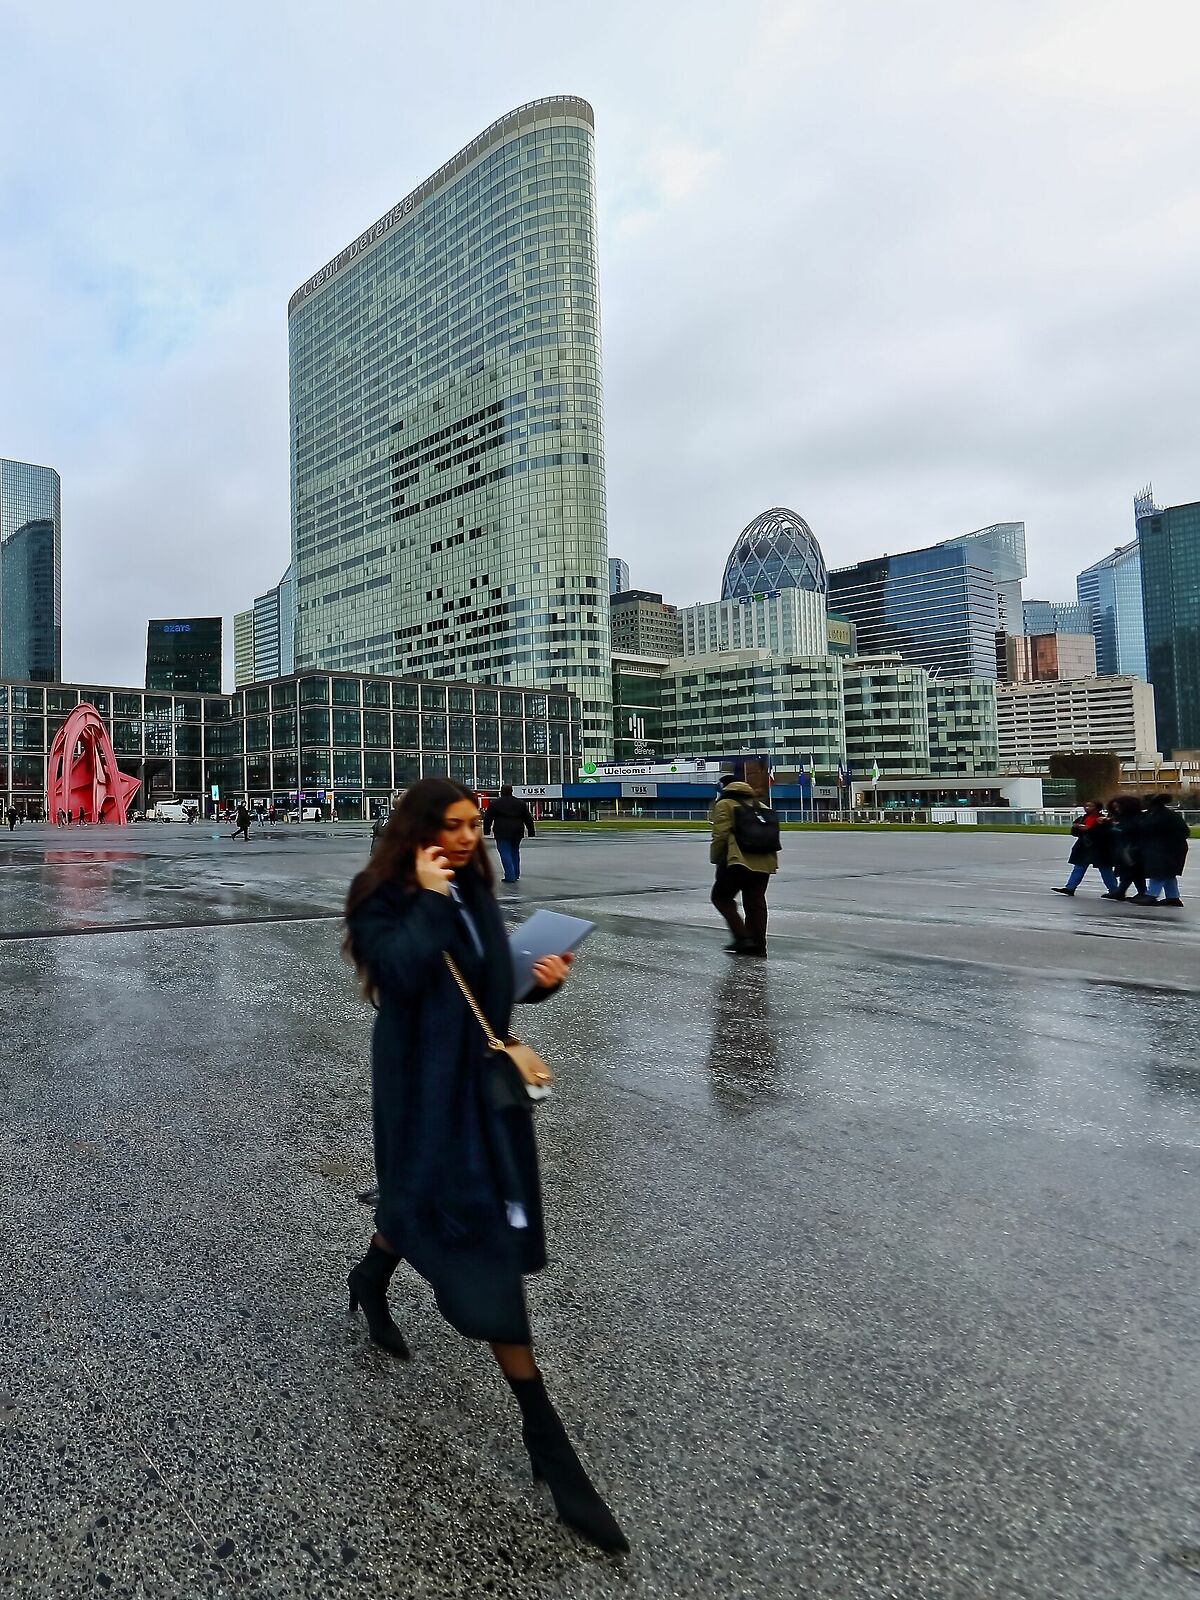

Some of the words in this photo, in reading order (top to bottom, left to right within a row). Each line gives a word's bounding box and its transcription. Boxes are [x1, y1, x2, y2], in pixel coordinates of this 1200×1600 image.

[151, 623, 192, 633] azars
[604, 767, 646, 775] Welcome
[521, 787, 546, 795] TUSK
